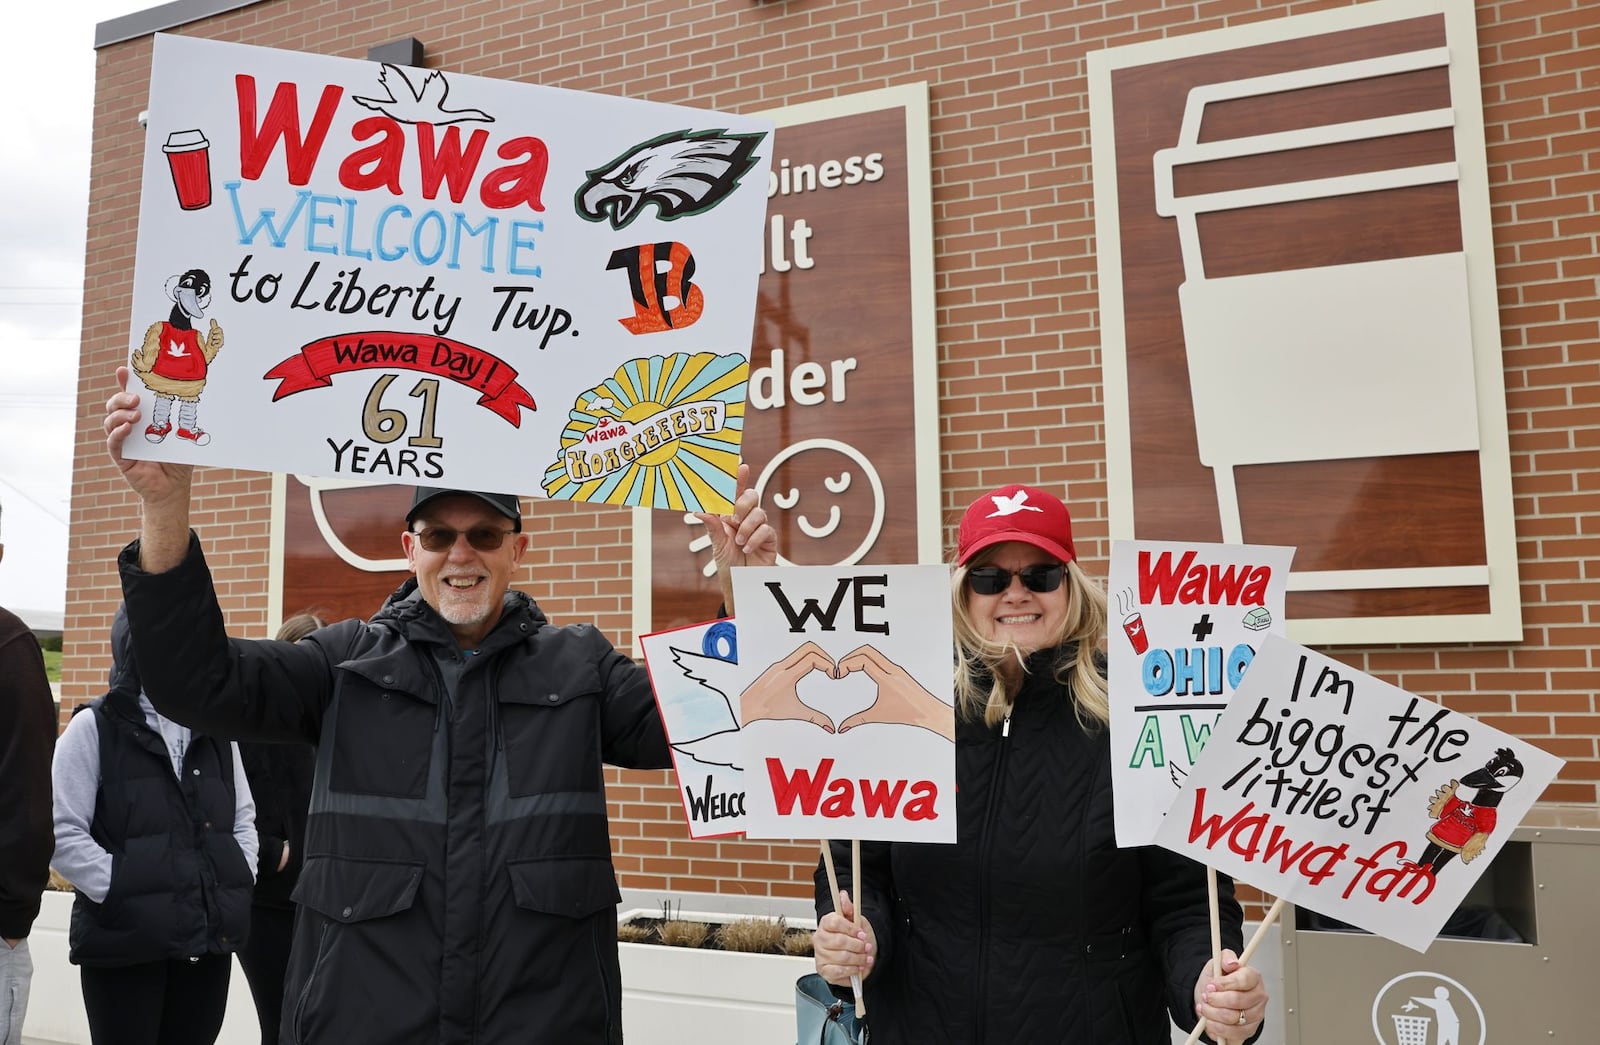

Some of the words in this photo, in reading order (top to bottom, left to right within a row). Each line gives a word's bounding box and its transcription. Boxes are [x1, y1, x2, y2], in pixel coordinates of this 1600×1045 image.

[235, 74, 550, 213] Wawa
[223, 180, 545, 278] WELCOME
[760, 214, 815, 274] lt
[229, 254, 282, 304] to
[290, 261, 462, 336] Liberty
[492, 286, 580, 350] Twp.
[332, 340, 418, 366] Wawa
[430, 342, 499, 389] Day!
[361, 374, 443, 449] 61
[567, 406, 718, 479] HOAGIEFEST
[586, 424, 628, 444] Wawa
[326, 437, 444, 479] YEARS
[764, 574, 890, 636] WE
[1138, 551, 1271, 606] Wawa
[1129, 715, 1165, 769] A
[1236, 697, 1429, 797] biggest
[1387, 698, 1469, 763] the
[765, 757, 939, 822] Wawa
[1222, 757, 1390, 835] littlest
[1341, 840, 1436, 905] fan
